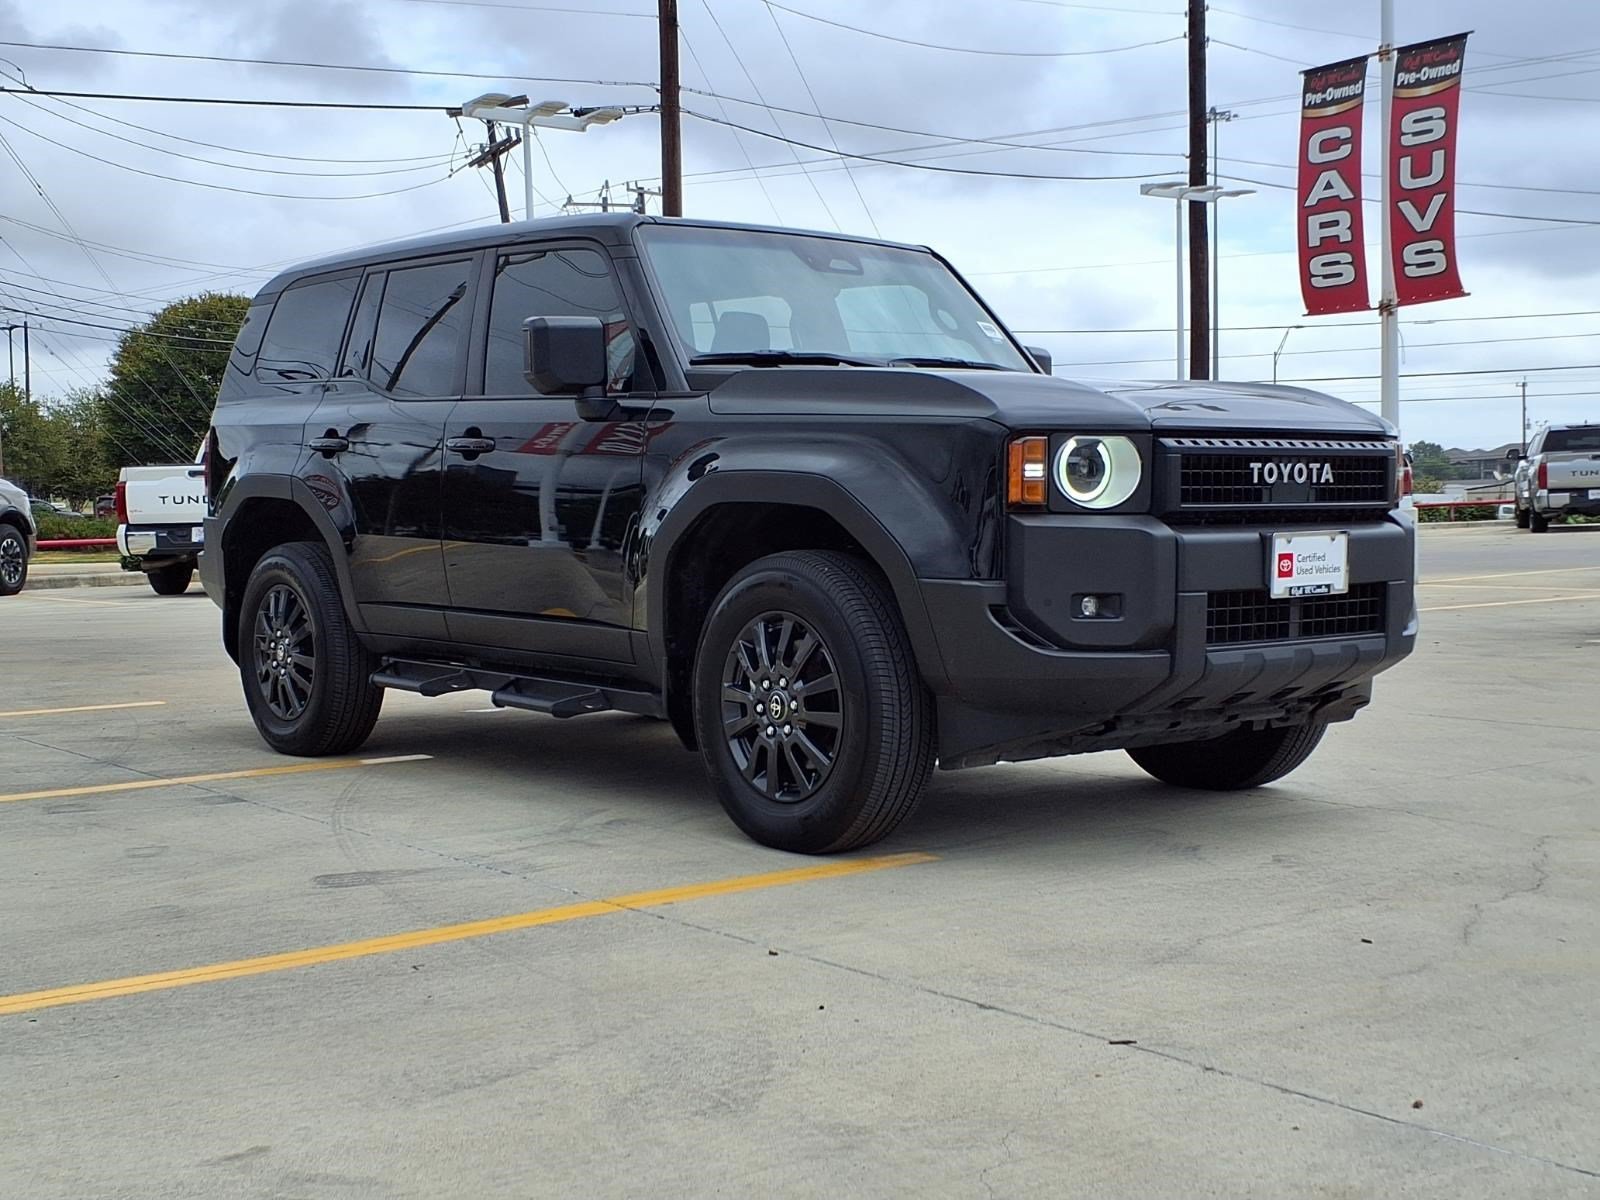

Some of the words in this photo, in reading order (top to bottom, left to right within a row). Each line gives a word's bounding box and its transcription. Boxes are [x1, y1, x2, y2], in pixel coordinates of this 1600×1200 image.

[1397, 60, 1460, 86] Pre-Owned
[1305, 80, 1362, 106] Pre-Owned
[1397, 106, 1448, 278] SUVS
[1304, 126, 1356, 288] CARS
[1249, 462, 1334, 484] TOYOTA
[1296, 566, 1313, 575] Used
[1315, 564, 1341, 574] Vehicles
[1297, 553, 1326, 563] Certified
